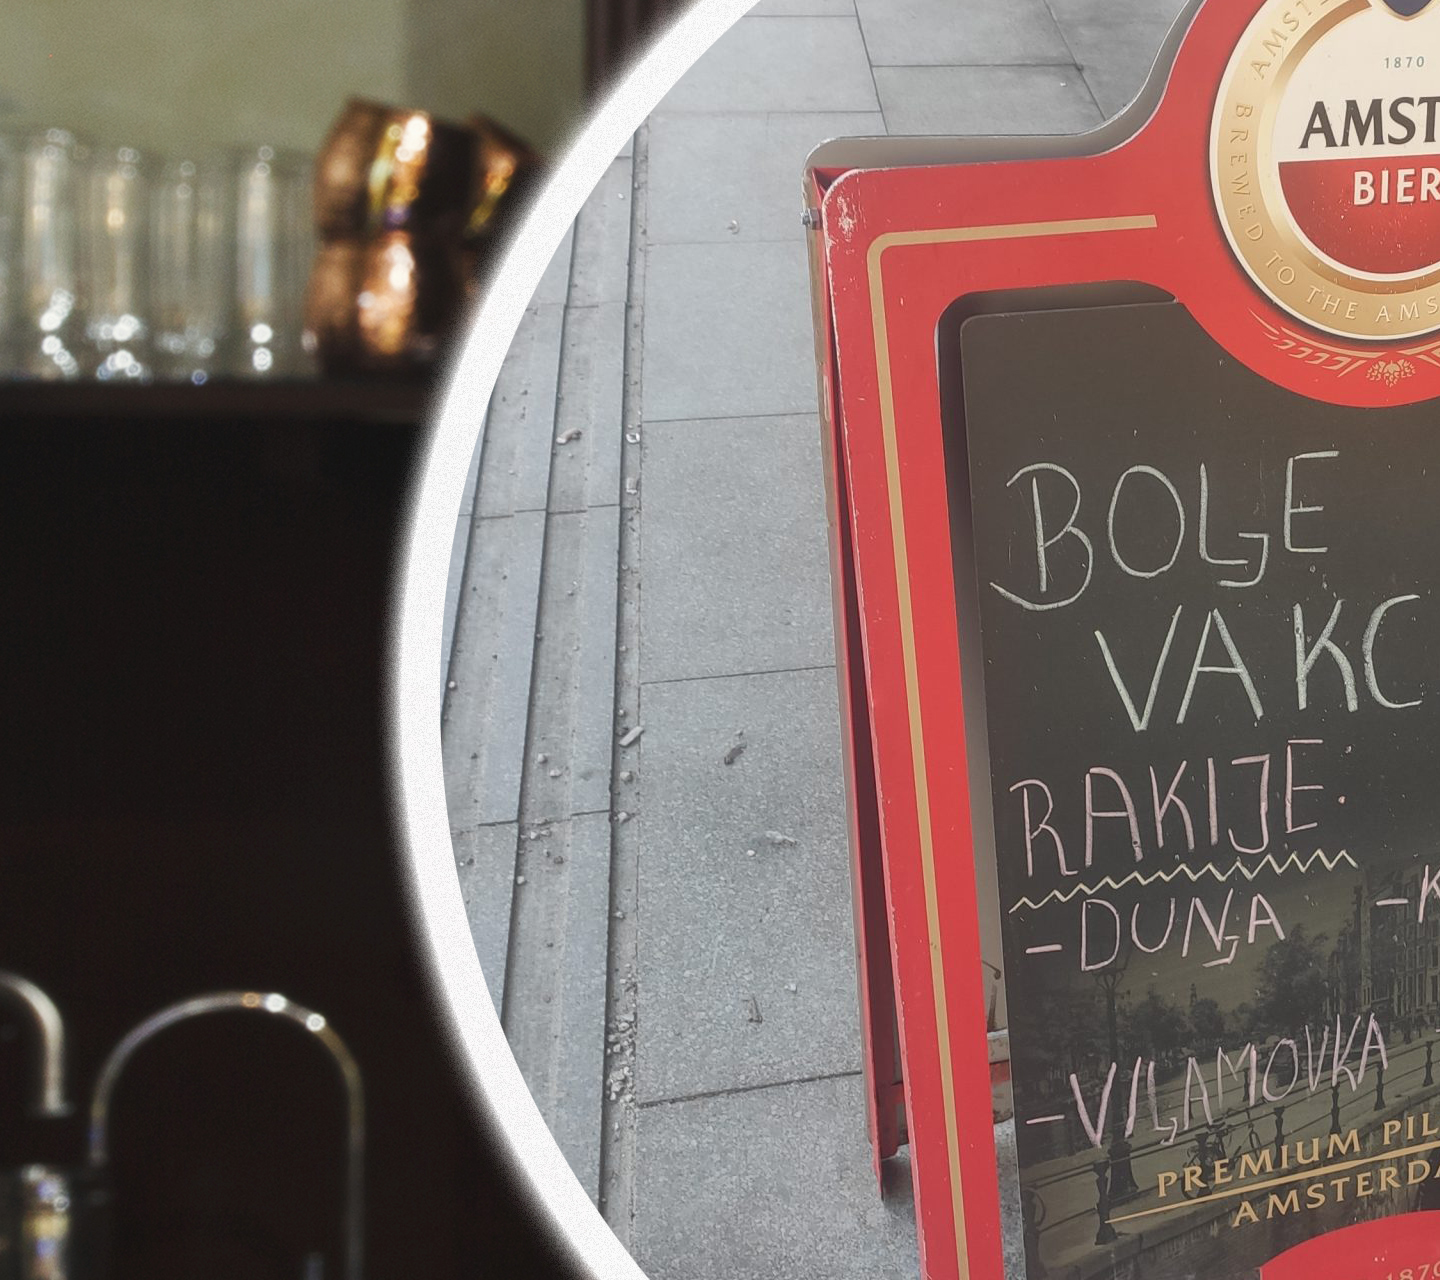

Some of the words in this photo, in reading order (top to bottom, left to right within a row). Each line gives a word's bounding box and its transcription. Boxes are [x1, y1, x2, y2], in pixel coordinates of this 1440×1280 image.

[1383, 55, 1426, 69] 1870
[1229, 103, 1265, 242] BREWED
[1265, 250, 1296, 286] TO
[1305, 284, 1359, 320] THE
[1156, 1128, 1363, 1199] PREMIUM
